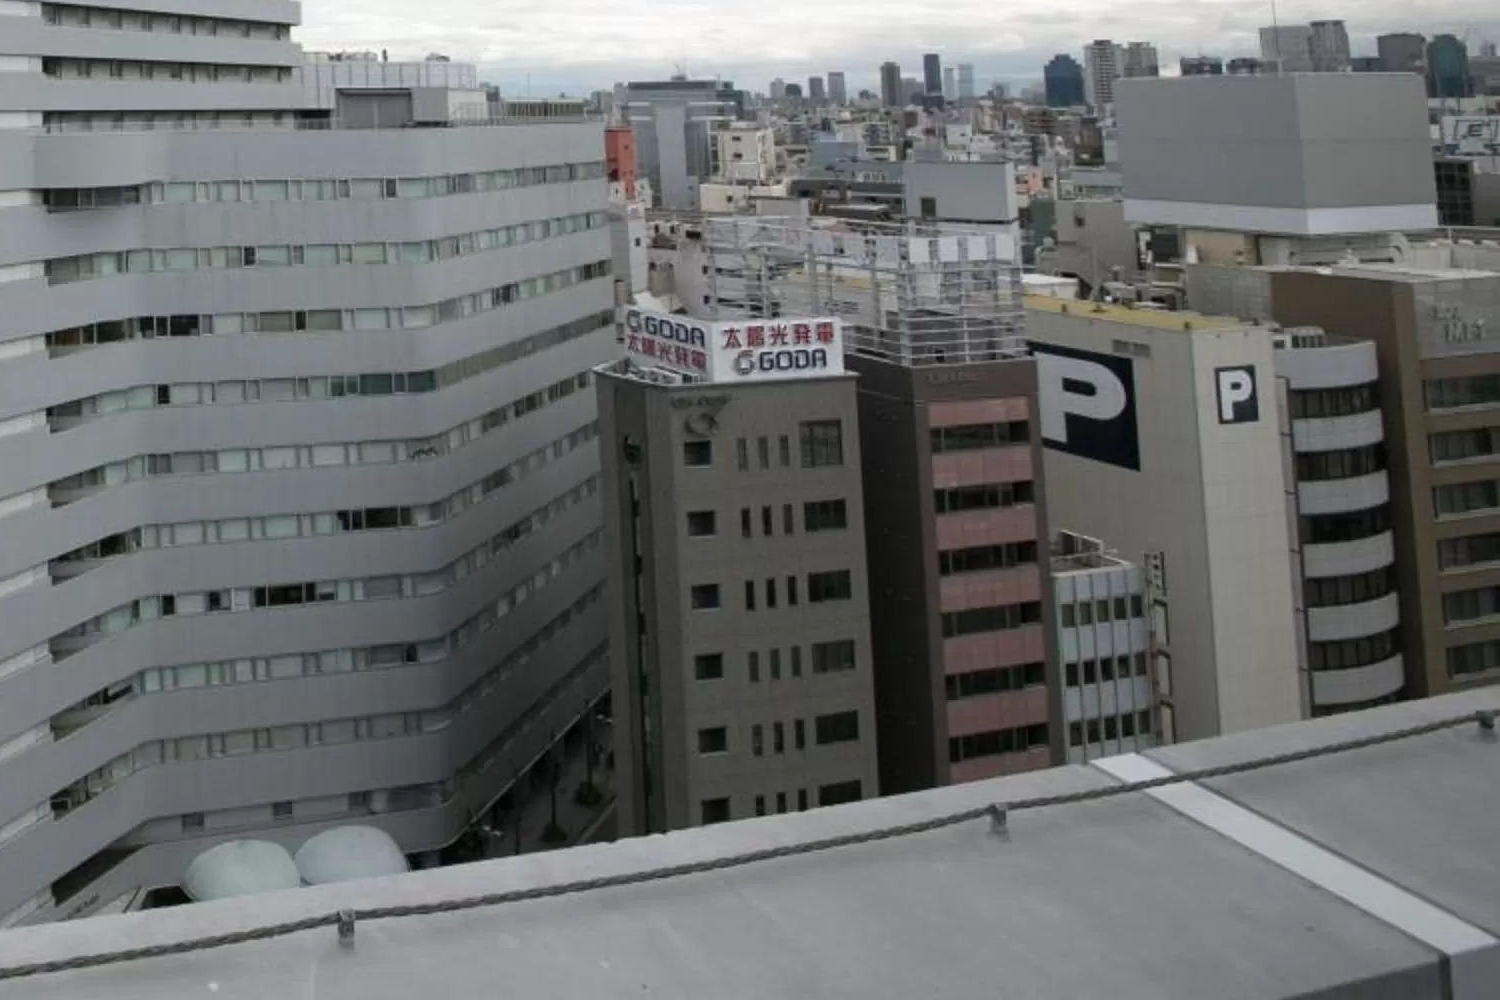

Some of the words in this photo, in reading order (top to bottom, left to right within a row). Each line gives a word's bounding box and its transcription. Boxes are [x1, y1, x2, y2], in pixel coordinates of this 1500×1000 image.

[645, 316, 705, 347] GODA
[722, 321, 834, 349] 太陽光発電
[759, 348, 827, 371] GODA
[1033, 351, 1127, 443] P
[1219, 369, 1253, 421] P
